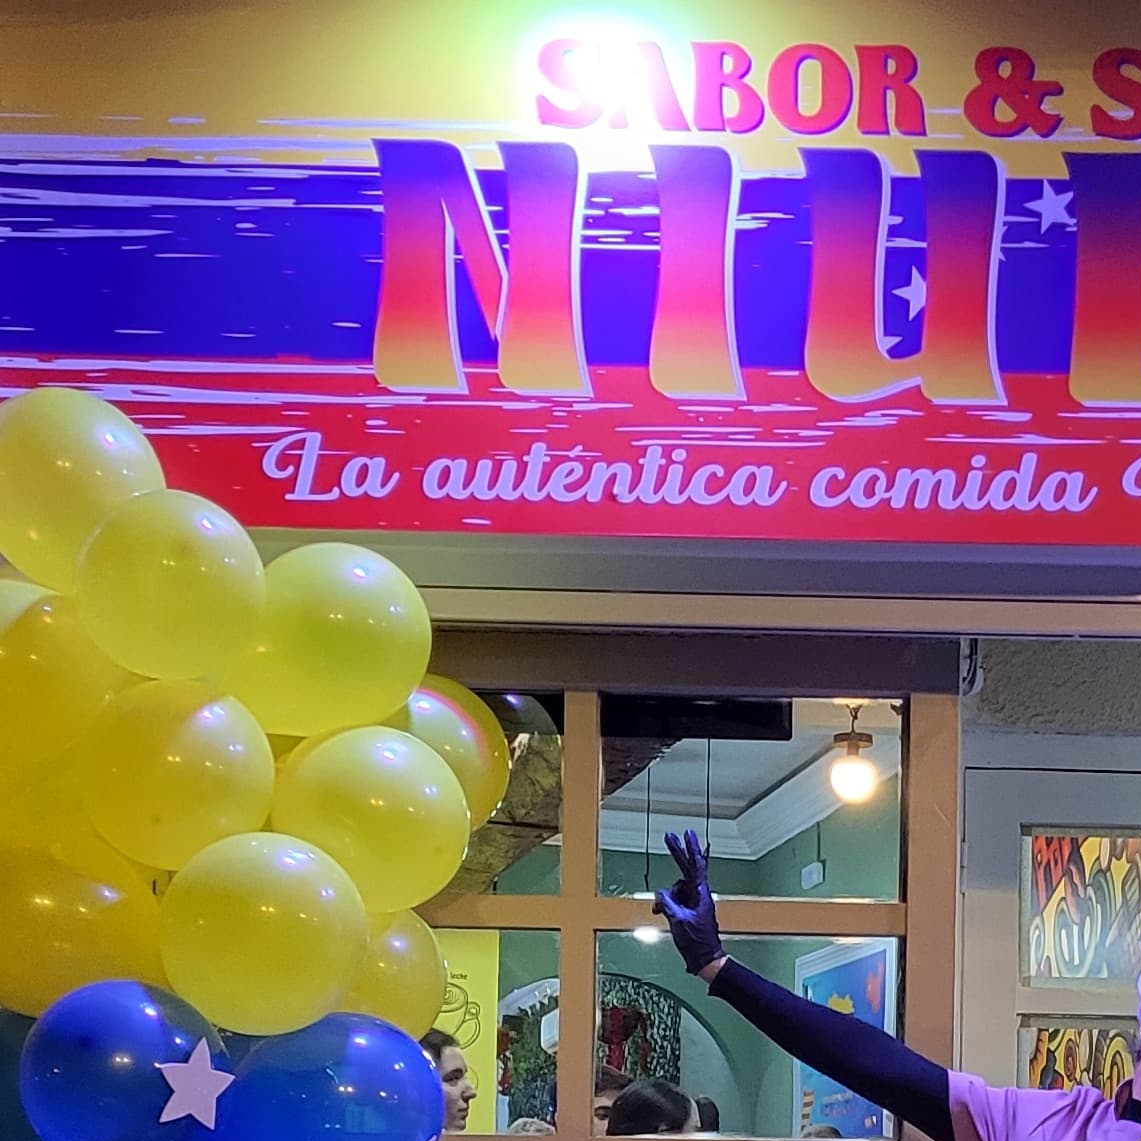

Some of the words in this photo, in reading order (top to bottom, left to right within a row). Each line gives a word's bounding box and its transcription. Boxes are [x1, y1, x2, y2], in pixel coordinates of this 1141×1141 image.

[535, 38, 926, 136] SABOR
[963, 46, 1064, 139] &
[262, 431, 400, 501] La
[421, 442, 788, 507] auténtica
[808, 452, 1097, 513] comida
